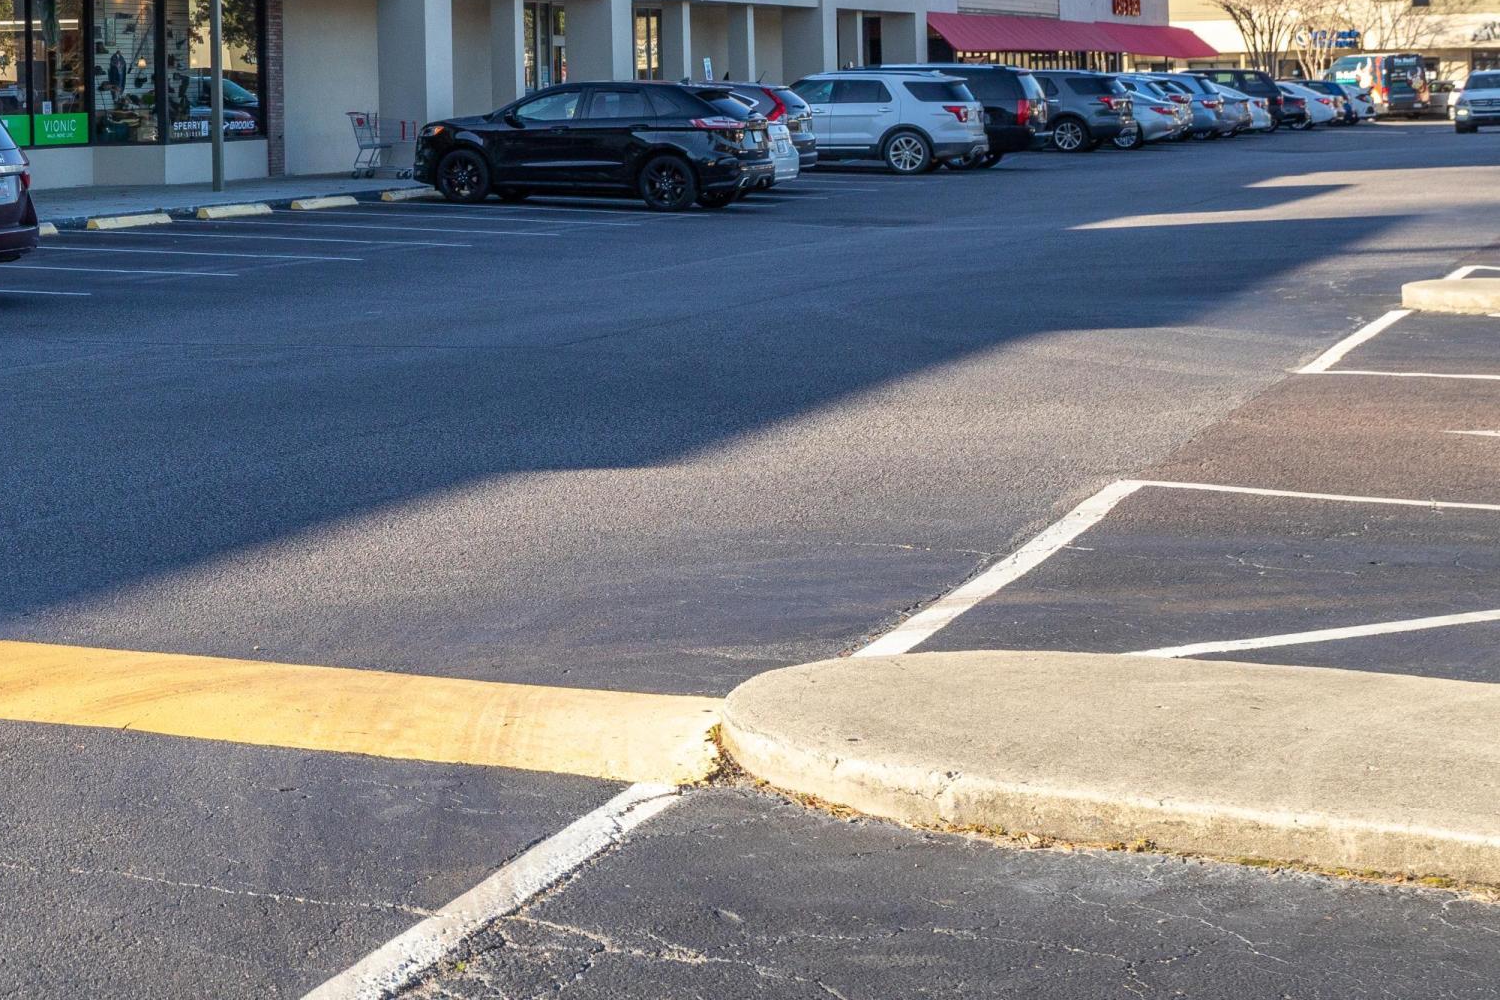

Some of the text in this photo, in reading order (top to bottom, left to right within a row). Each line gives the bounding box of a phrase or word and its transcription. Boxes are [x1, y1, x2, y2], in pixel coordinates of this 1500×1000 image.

[43, 119, 77, 132] VIONIC
[173, 121, 200, 131] SPERRY
[229, 121, 255, 130] BROOKS
